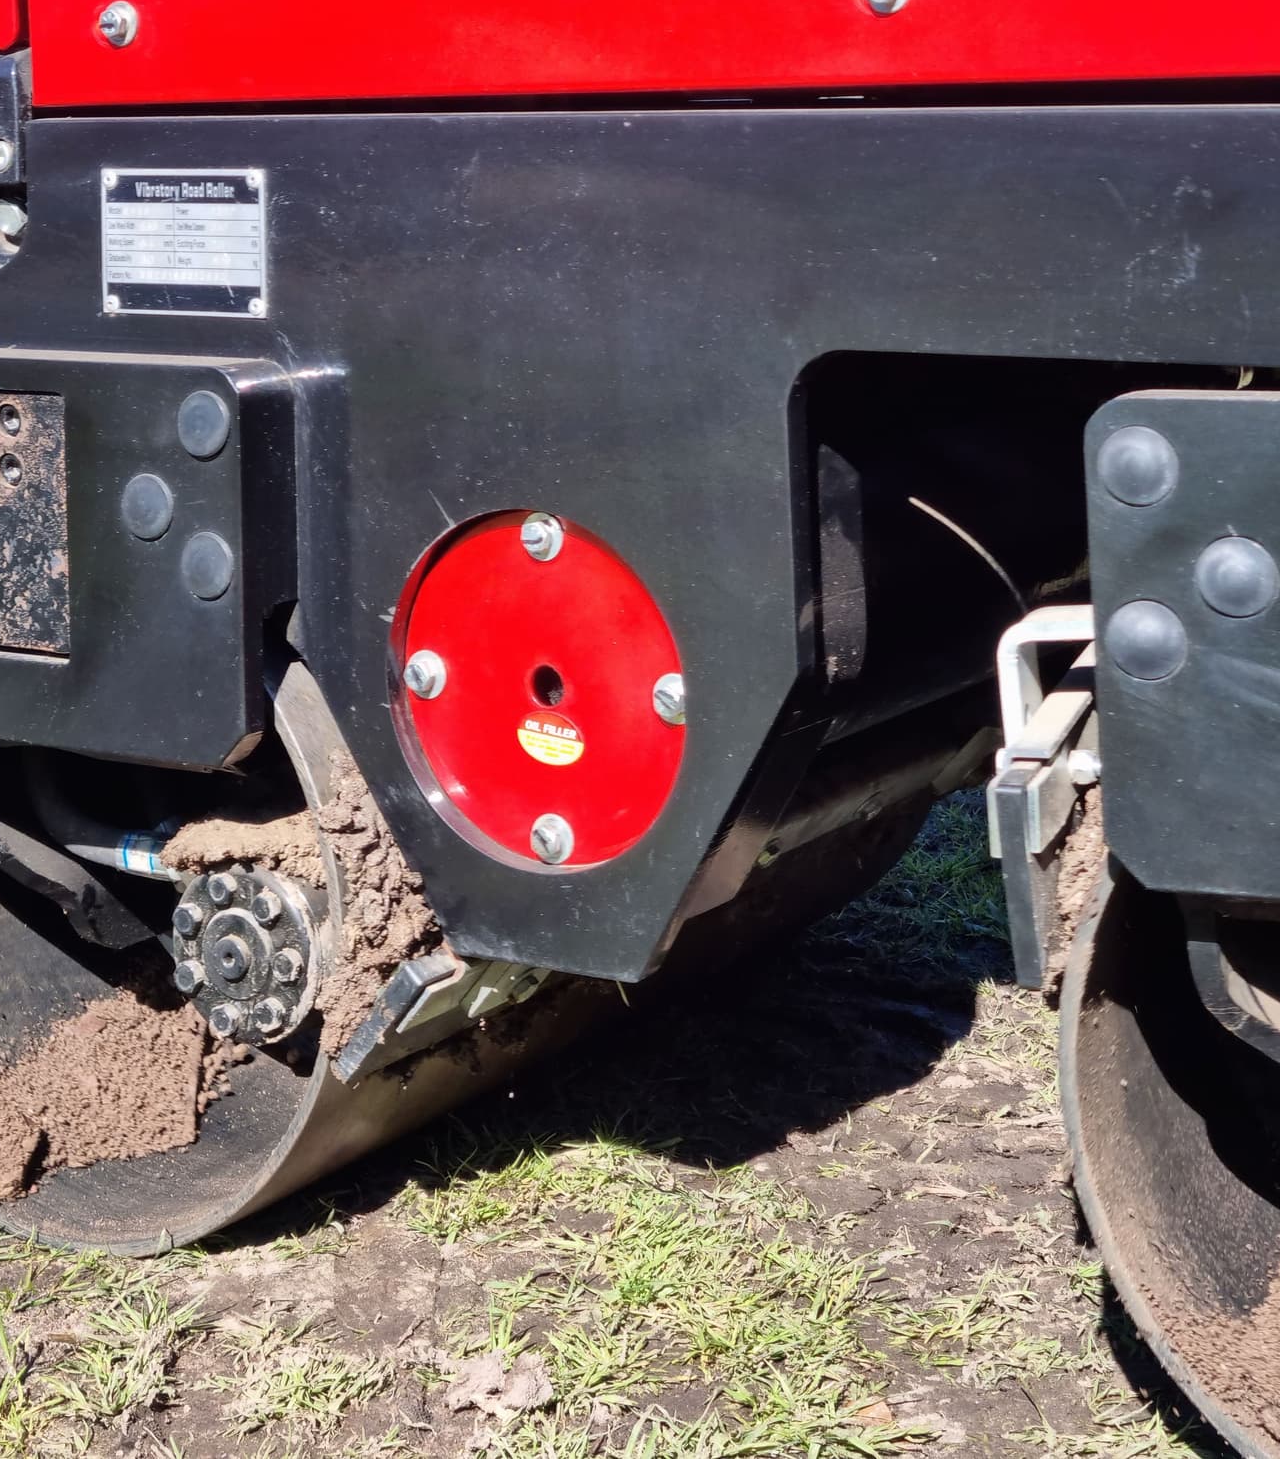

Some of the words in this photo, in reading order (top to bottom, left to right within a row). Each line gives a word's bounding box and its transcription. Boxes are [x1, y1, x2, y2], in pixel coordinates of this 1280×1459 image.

[135, 182, 180, 201] Vibratory
[181, 182, 204, 198] Road
[206, 182, 235, 198] Roller
[525, 720, 541, 732] OIL
[543, 723, 577, 739] FILLER
